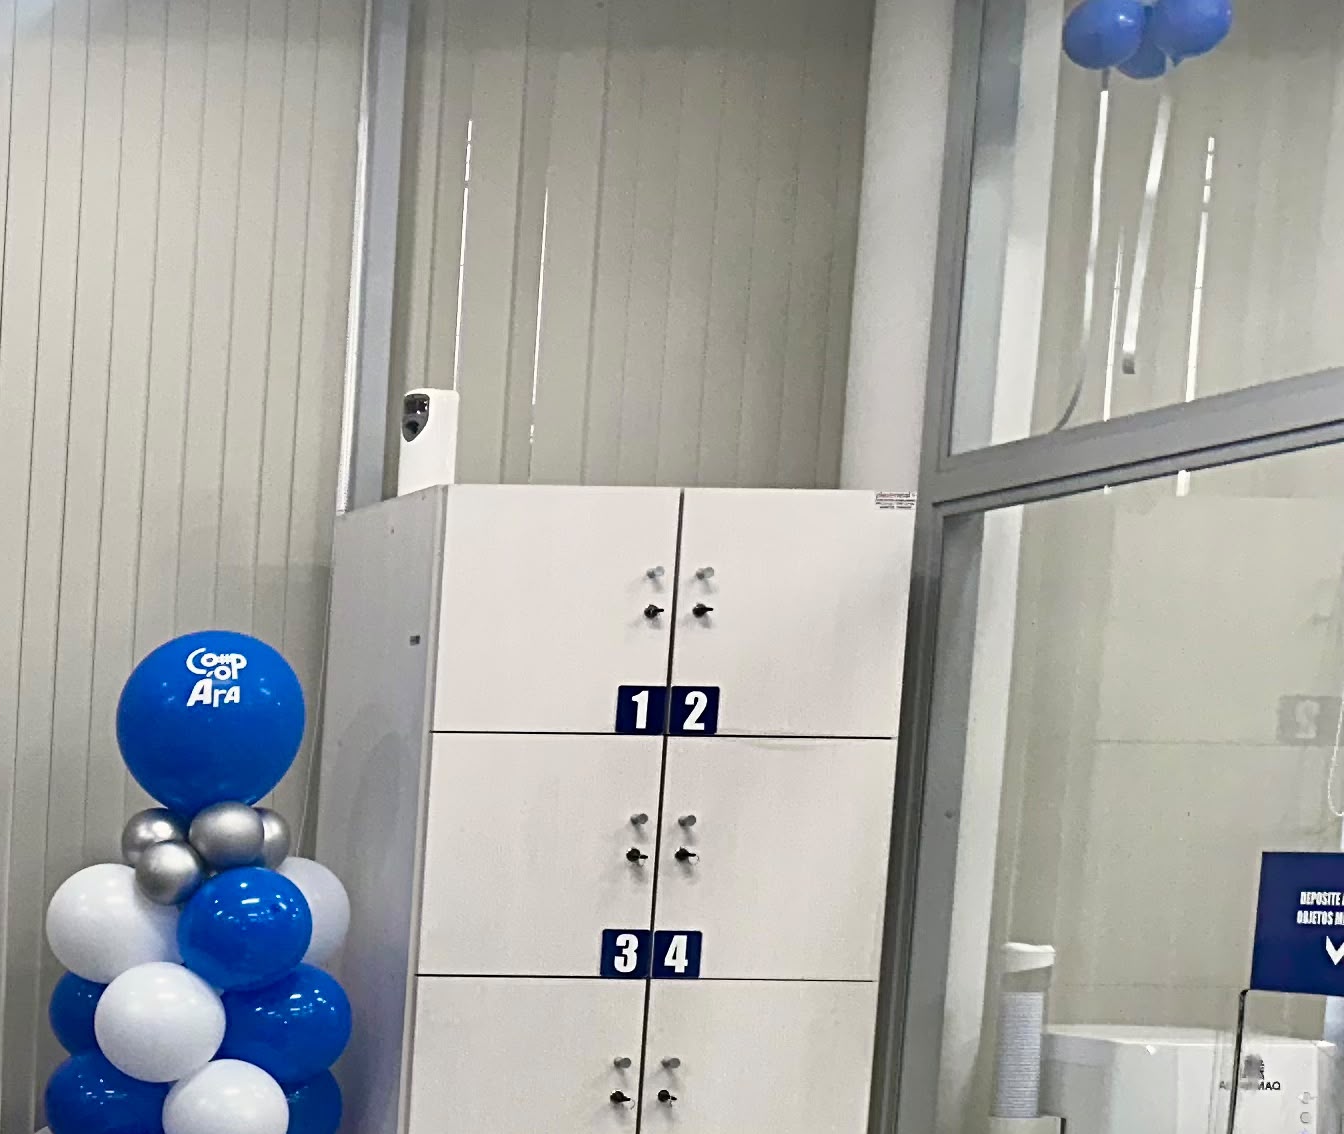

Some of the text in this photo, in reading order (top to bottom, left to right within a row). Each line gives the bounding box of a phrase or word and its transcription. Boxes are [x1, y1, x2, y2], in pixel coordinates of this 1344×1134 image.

[631, 690, 649, 729] 1
[682, 690, 708, 731] 2
[614, 933, 639, 973] 3
[663, 934, 689, 973] 4
